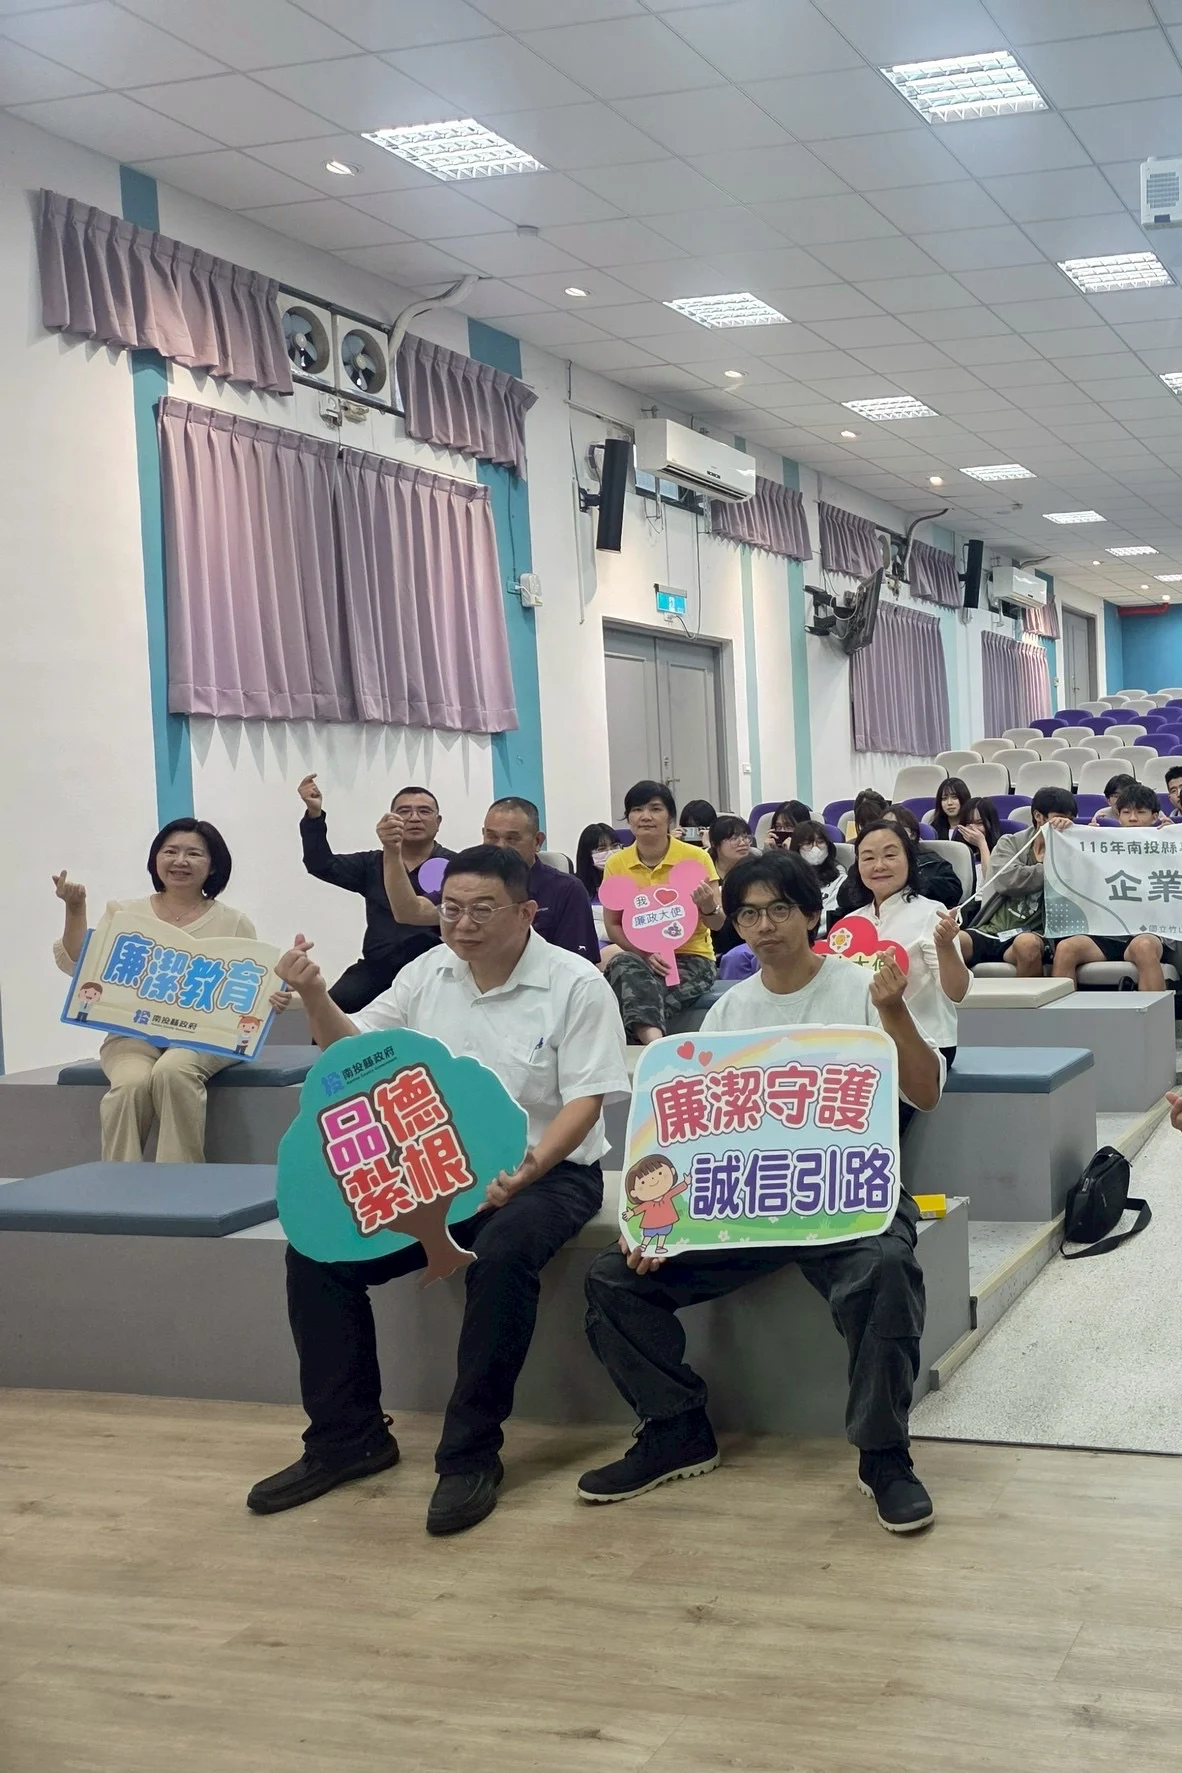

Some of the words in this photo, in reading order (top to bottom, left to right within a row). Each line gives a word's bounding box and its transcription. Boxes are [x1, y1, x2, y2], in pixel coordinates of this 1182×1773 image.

[633, 907, 683, 927] 廉政大使
[636, 895, 648, 907] 我
[101, 932, 267, 1013] 廉潔教育
[152, 1014, 198, 1030] 南投縣政府
[342, 1045, 395, 1080] 南投縣政府
[321, 1066, 449, 1175] 品德
[652, 1063, 880, 1145] 廉潔守護
[342, 1124, 474, 1233] 紮根
[689, 1145, 894, 1218] 誠信引路
